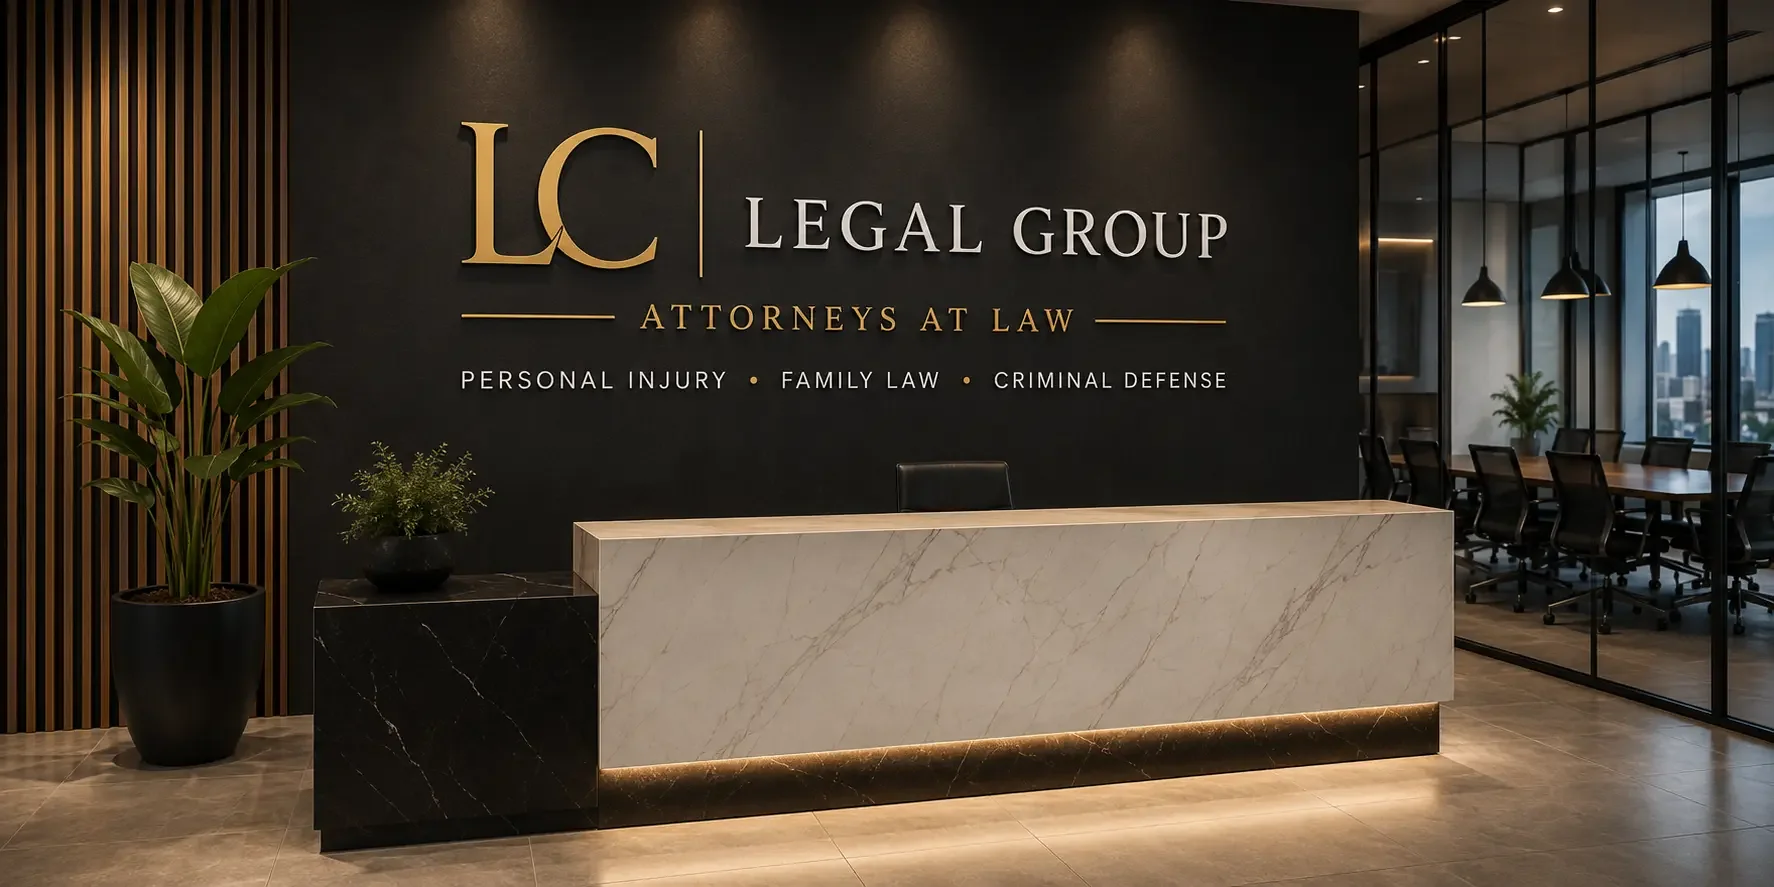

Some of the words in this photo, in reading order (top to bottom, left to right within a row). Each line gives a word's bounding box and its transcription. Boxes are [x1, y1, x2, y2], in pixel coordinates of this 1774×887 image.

[461, 121, 658, 270] LC
[745, 196, 983, 253] LEGAL
[1013, 206, 1228, 259] GROUP
[640, 303, 896, 332] ATTORNEYS
[920, 307, 968, 332] AT
[992, 307, 1074, 333] LAW
[461, 371, 614, 390] PERSONAL
[629, 371, 726, 390] INJURY
[782, 371, 873, 389] FAMILY
[887, 371, 939, 389] LAW
[994, 371, 1112, 389] CRIMINAL
[1124, 371, 1226, 389] DEFENSE
